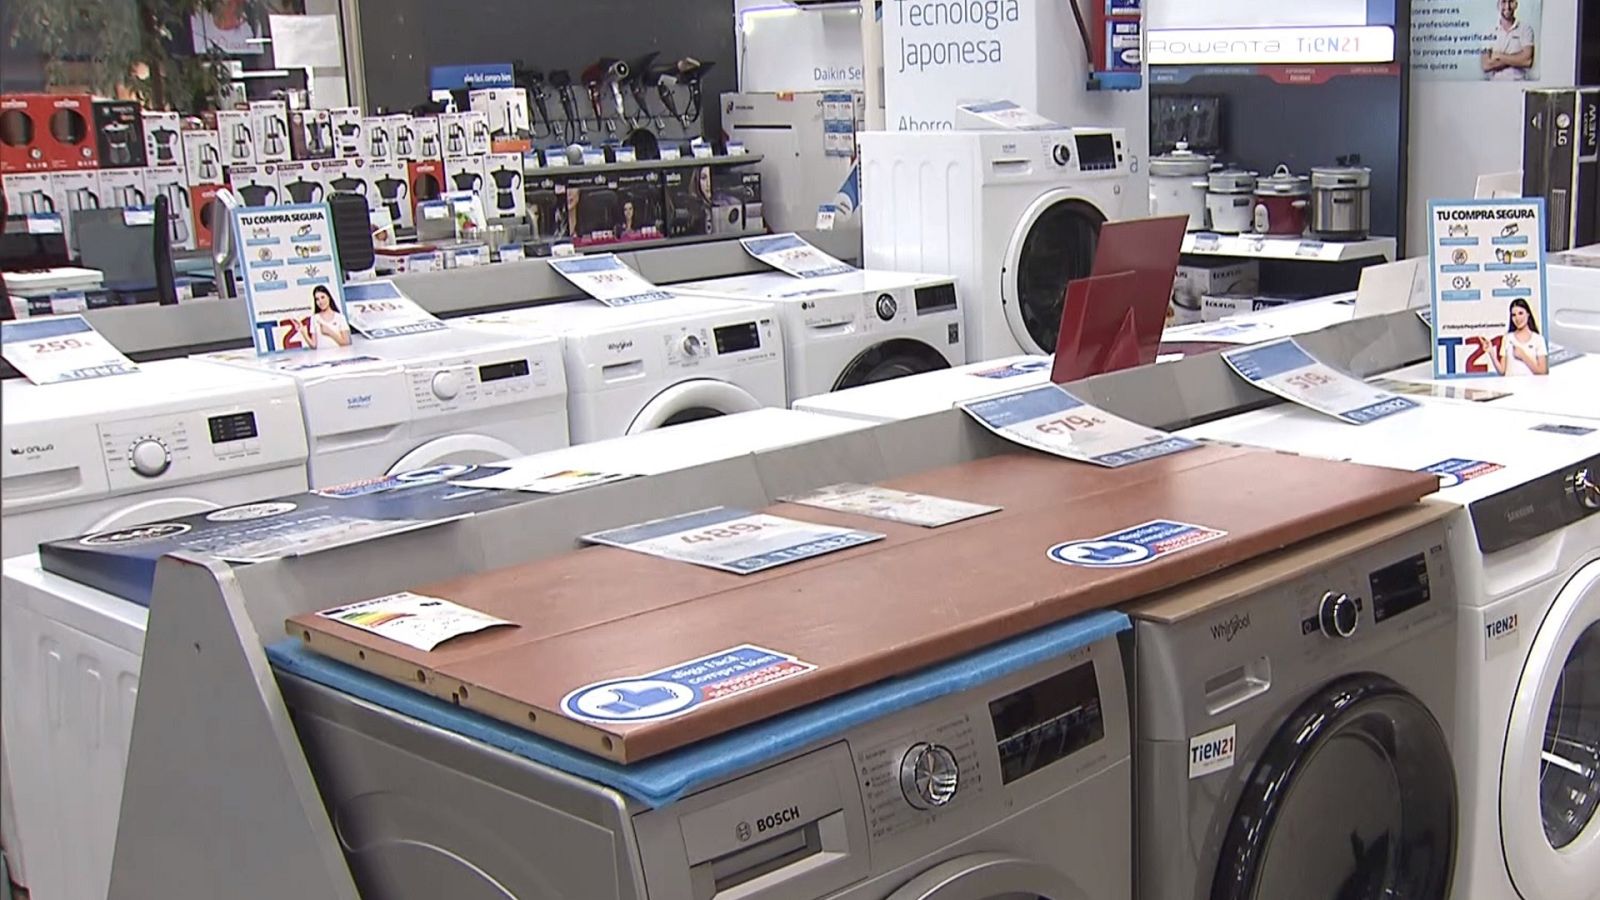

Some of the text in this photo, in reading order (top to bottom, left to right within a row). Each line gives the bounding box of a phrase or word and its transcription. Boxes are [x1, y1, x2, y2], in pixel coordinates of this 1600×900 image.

[1411, 7, 1460, 16] ores marcas
[1418, 20, 1470, 30] profesionales
[1412, 34, 1453, 42] certificada
[1460, 33, 1498, 42] verificada
[899, 36, 1002, 73] Japonesa
[1422, 48, 1456, 57] proyecto
[813, 67, 846, 81] Daikin
[1411, 62, 1459, 71] omo quieras
[898, 114, 953, 131] Ahorro
[1557, 129, 1568, 146] LG
[240, 211, 325, 226] TU COMPRA SEGURA
[1437, 208, 1535, 221] TU COMPRA SEGURA
[1437, 335, 1504, 375] T21
[1210, 612, 1251, 642] Whirlpool
[688, 663, 745, 685] compra
[756, 805, 800, 833] BOSCH
